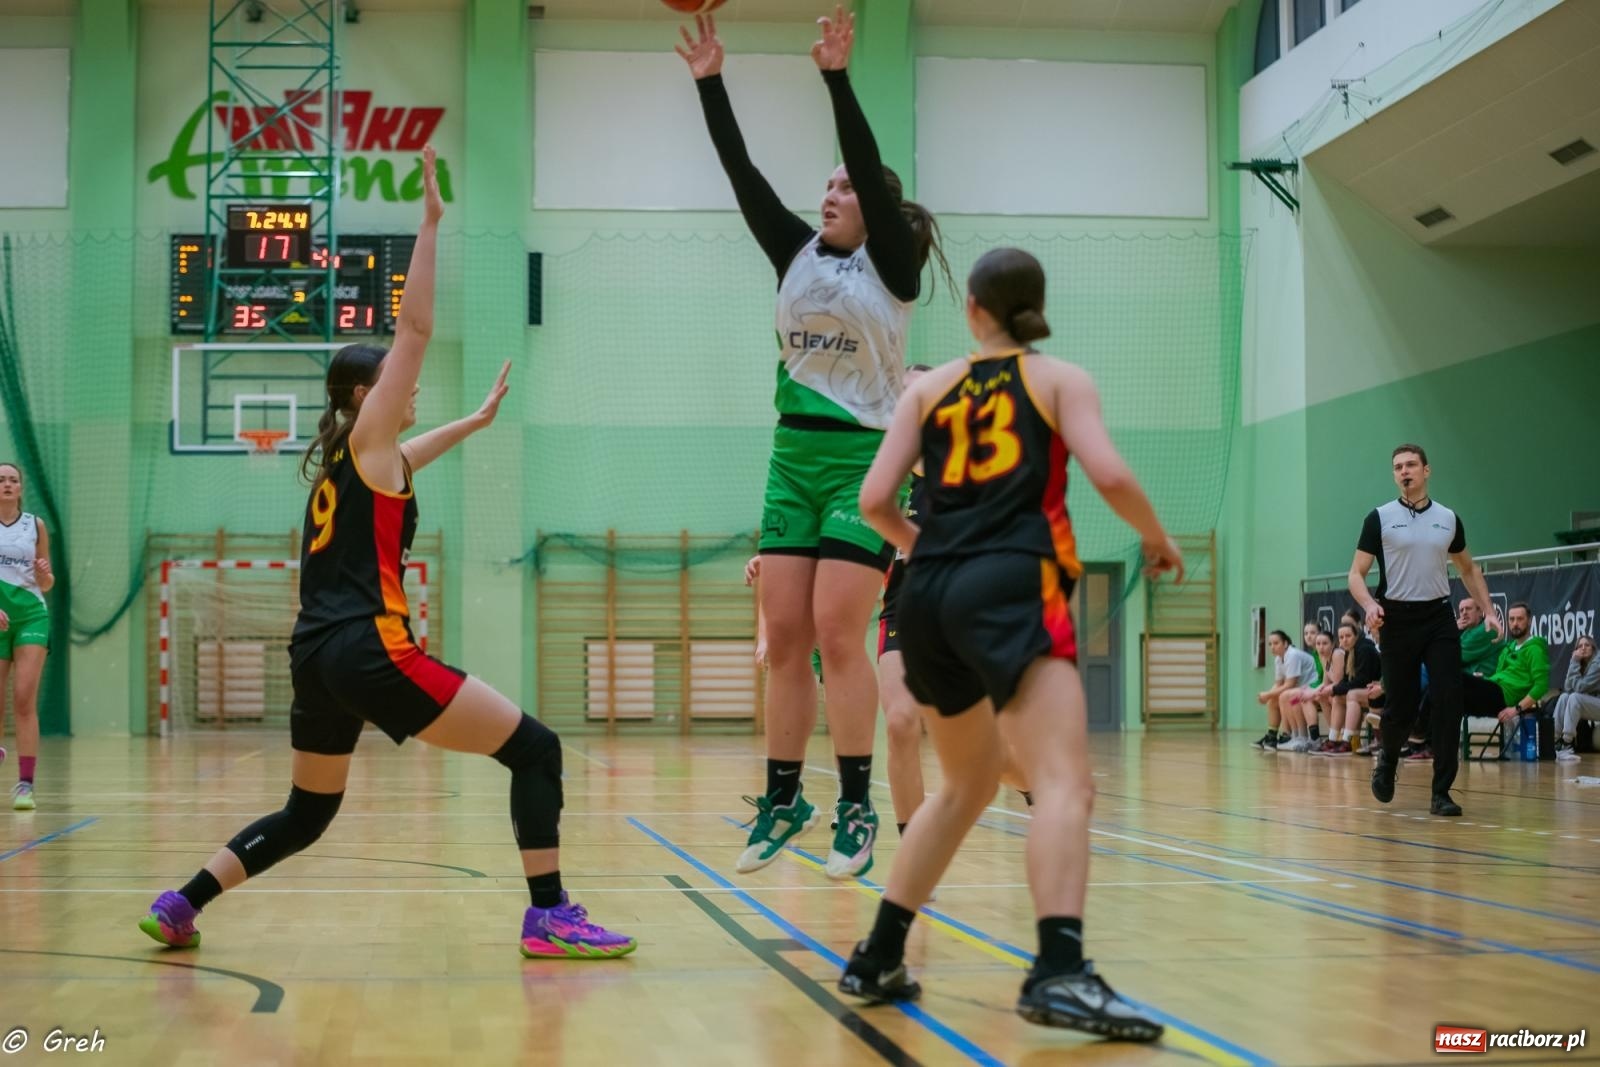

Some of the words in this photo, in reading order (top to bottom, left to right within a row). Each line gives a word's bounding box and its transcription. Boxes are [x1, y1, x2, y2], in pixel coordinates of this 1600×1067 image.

[259, 235, 290, 259] 17
[233, 305, 266, 328] 35
[339, 305, 374, 328] 21
[789, 330, 859, 353] Clavis
[934, 391, 1022, 487] 13
[309, 478, 338, 555] 9
[1530, 600, 1595, 646] ACIBÓRZ
